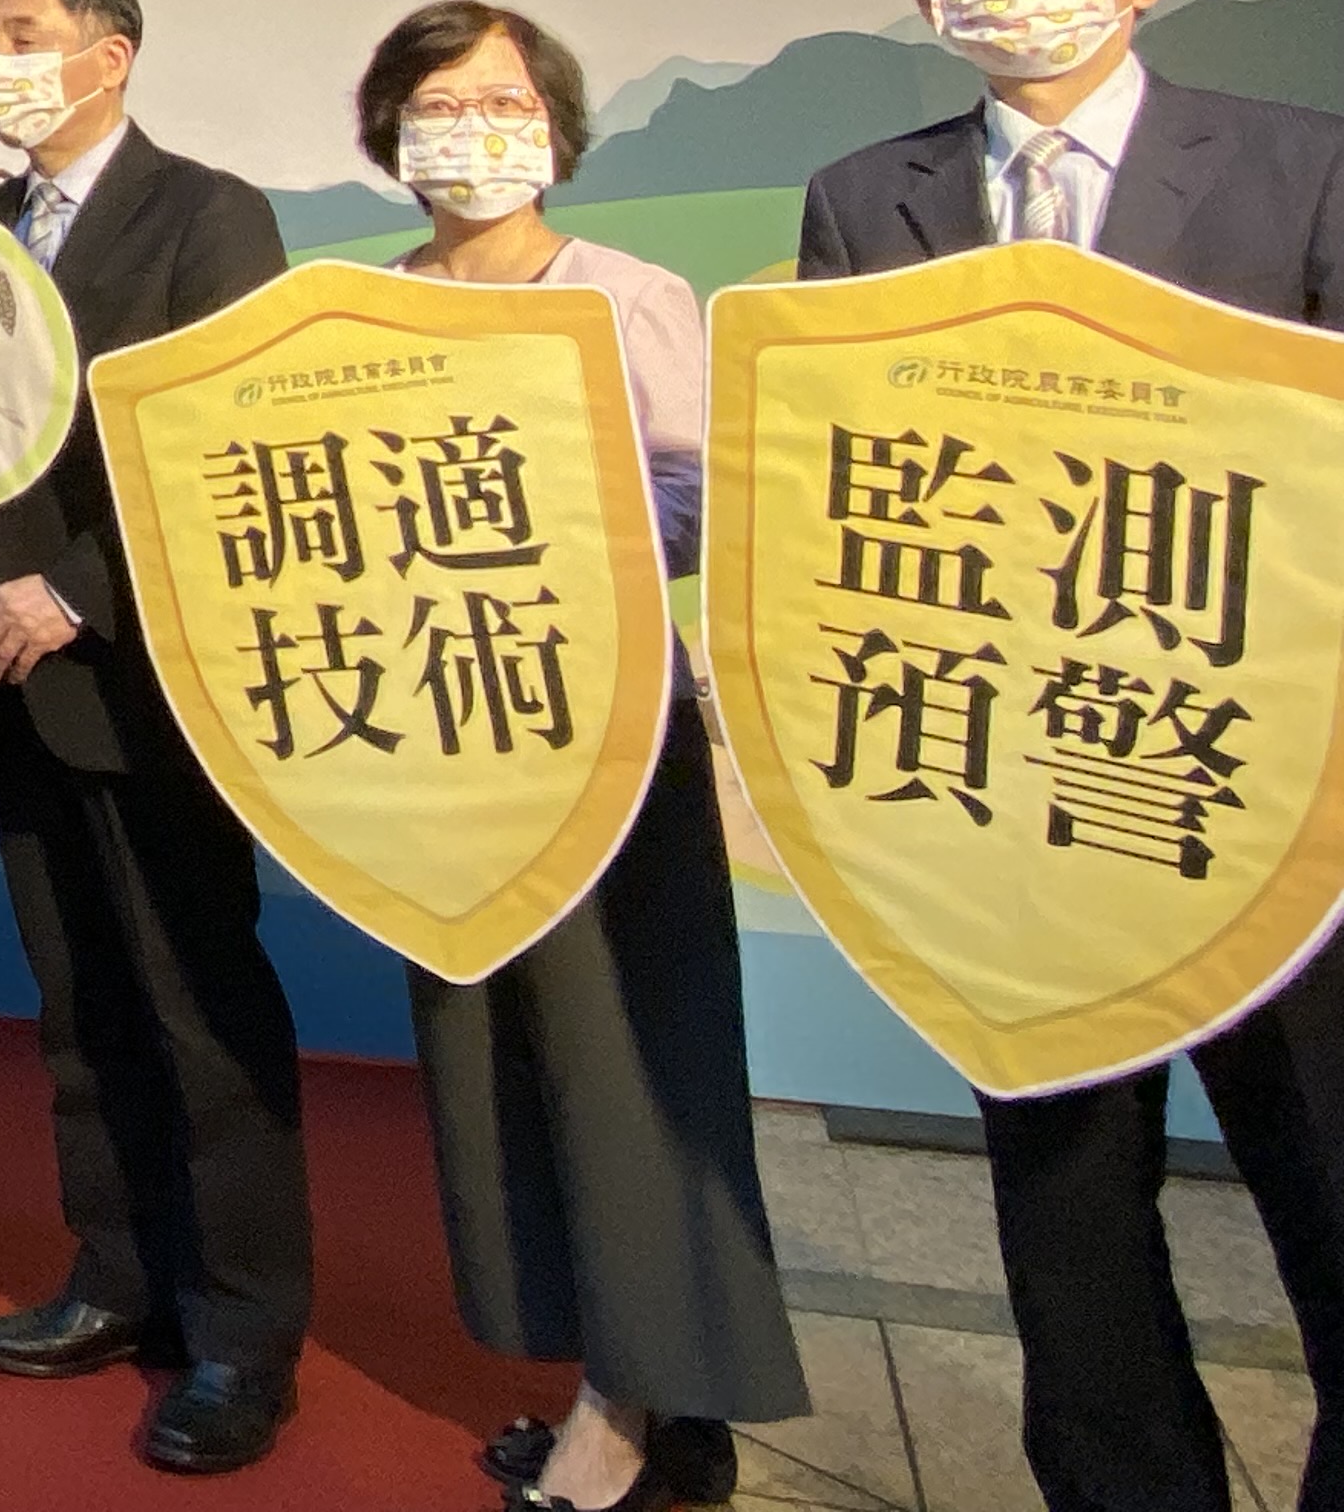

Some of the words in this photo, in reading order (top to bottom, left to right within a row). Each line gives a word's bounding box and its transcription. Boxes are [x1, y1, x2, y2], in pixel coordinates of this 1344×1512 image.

[203, 414, 550, 588] 調適
[814, 423, 1267, 668] 監測
[236, 585, 574, 760] 技術
[809, 623, 1253, 879] 預警
